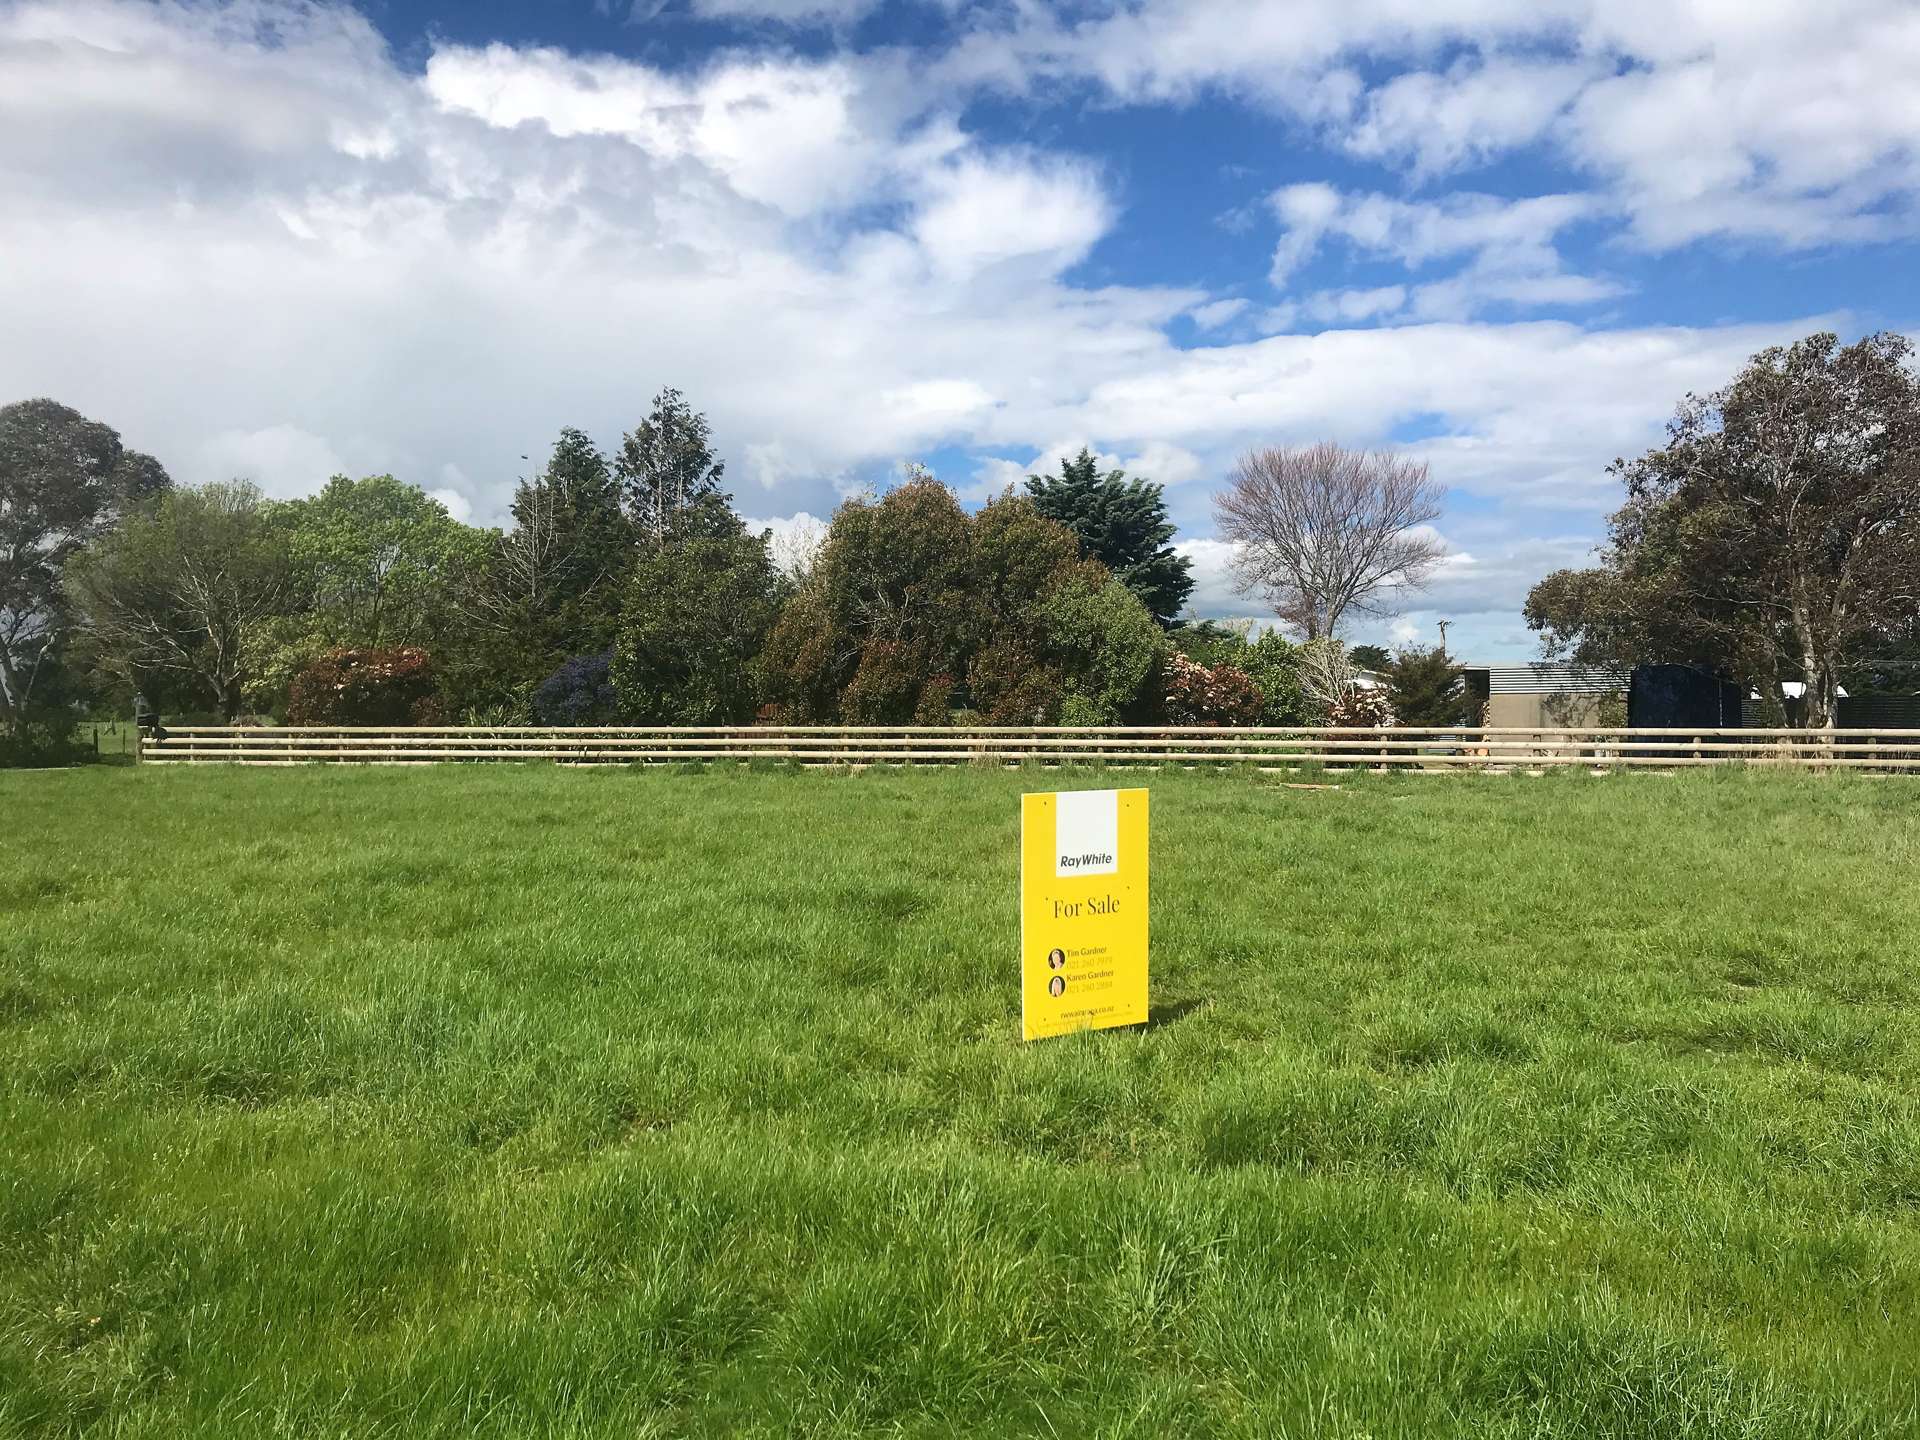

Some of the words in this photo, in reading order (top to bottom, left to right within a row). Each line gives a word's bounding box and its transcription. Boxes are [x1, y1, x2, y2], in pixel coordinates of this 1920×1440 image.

[1054, 900, 1082, 918] For
[1088, 895, 1120, 915] Sale
[1067, 949, 1079, 958] Tim
[1080, 947, 1107, 956] Gardner
[1066, 971, 1087, 981] Karen
[1088, 969, 1114, 979] Gardner
